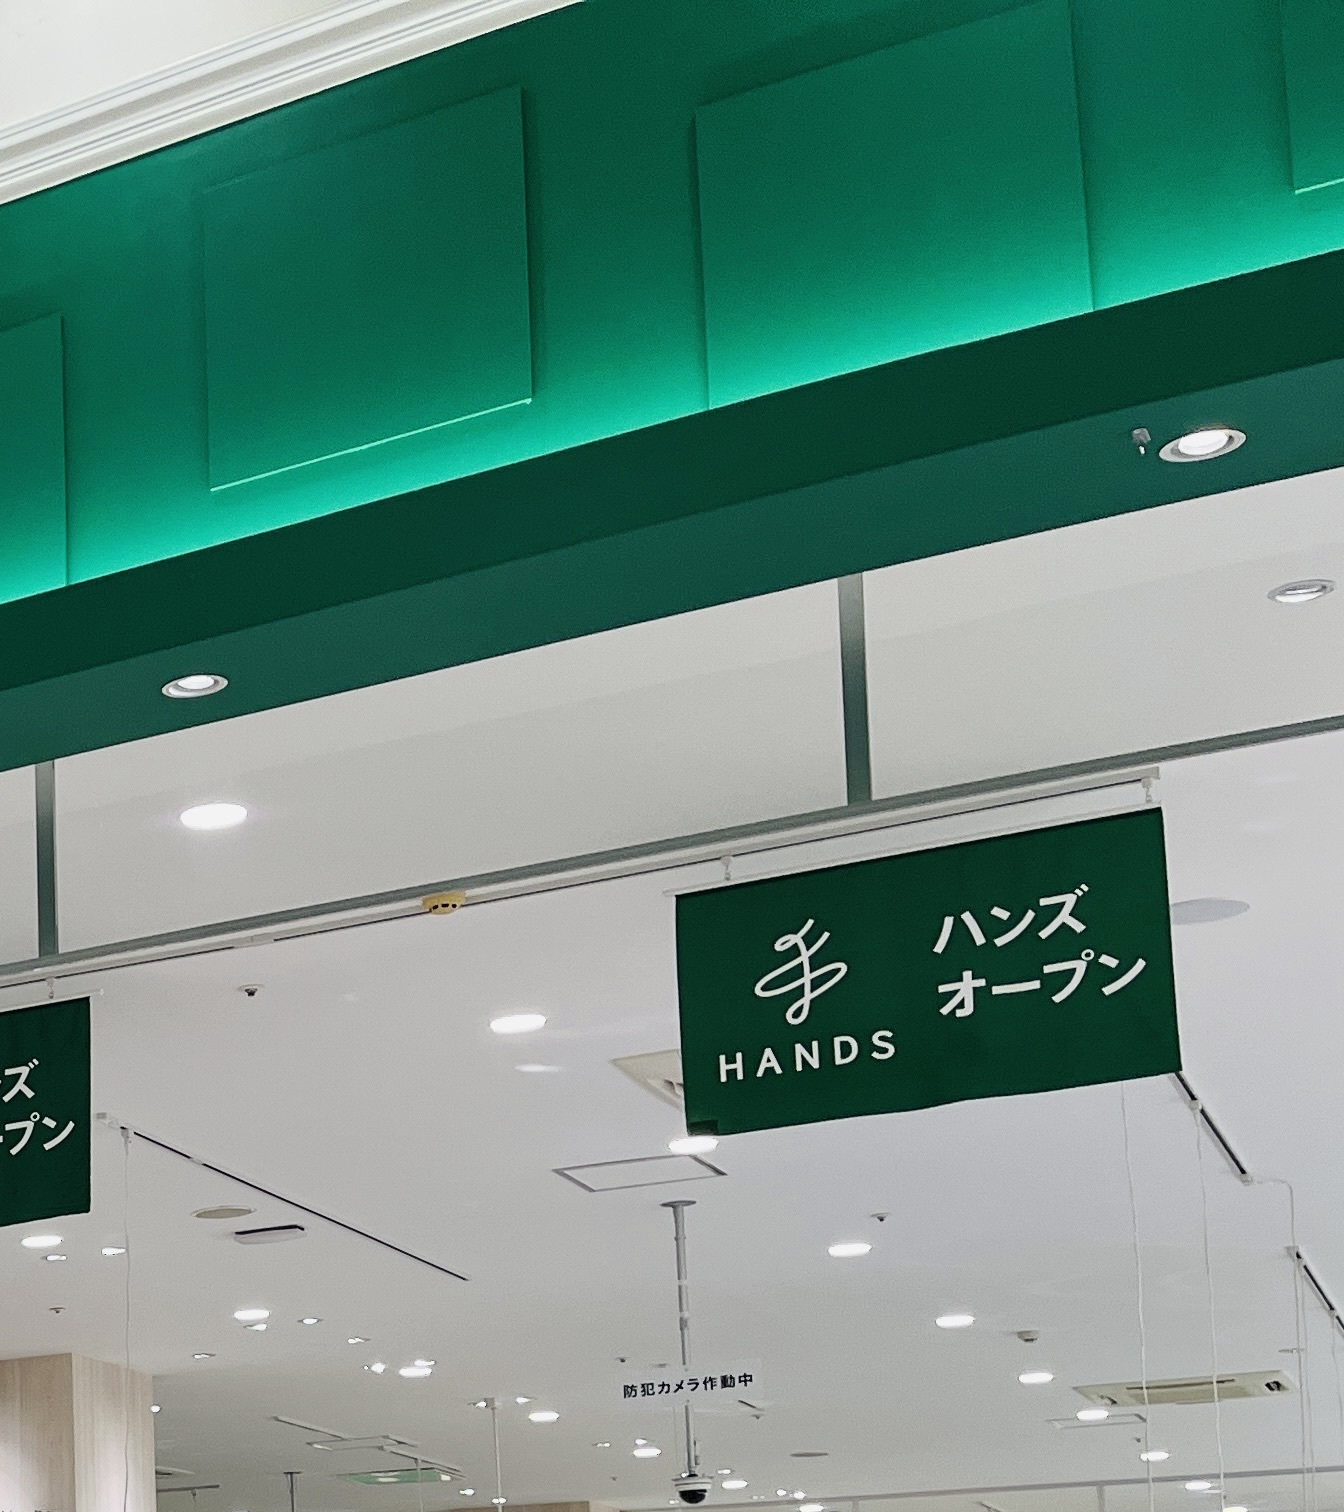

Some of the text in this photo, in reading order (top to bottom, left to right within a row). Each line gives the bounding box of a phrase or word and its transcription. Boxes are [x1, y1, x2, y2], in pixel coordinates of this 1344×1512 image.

[932, 884, 1089, 953] ハンズ
[937, 949, 1147, 1017] オープン
[718, 1030, 896, 1083] HANDS
[622, 1373, 754, 1399] 防犯カメラ作動中
